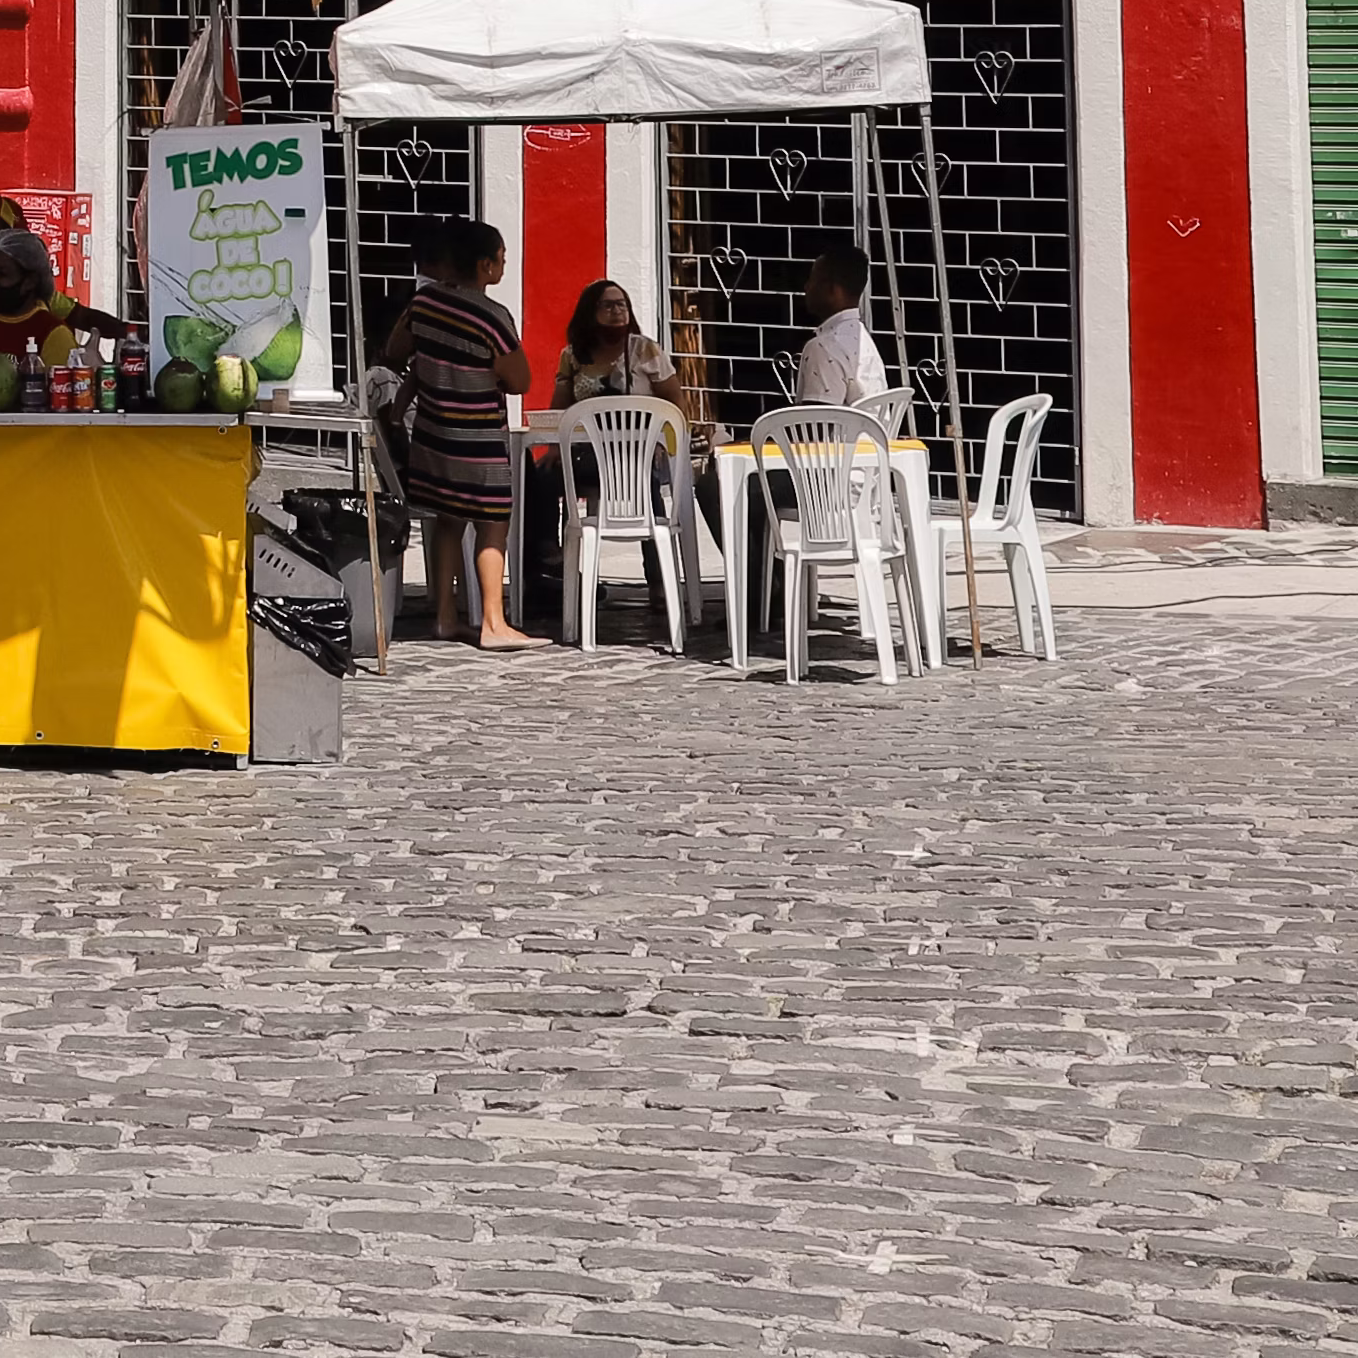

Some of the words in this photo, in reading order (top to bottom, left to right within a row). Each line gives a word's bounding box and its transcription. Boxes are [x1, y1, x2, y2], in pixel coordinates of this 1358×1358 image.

[165, 138, 303, 191] TEMOS
[189, 189, 282, 241] ÁGUA
[216, 235, 260, 267] DE
[188, 259, 292, 304] COCO!
